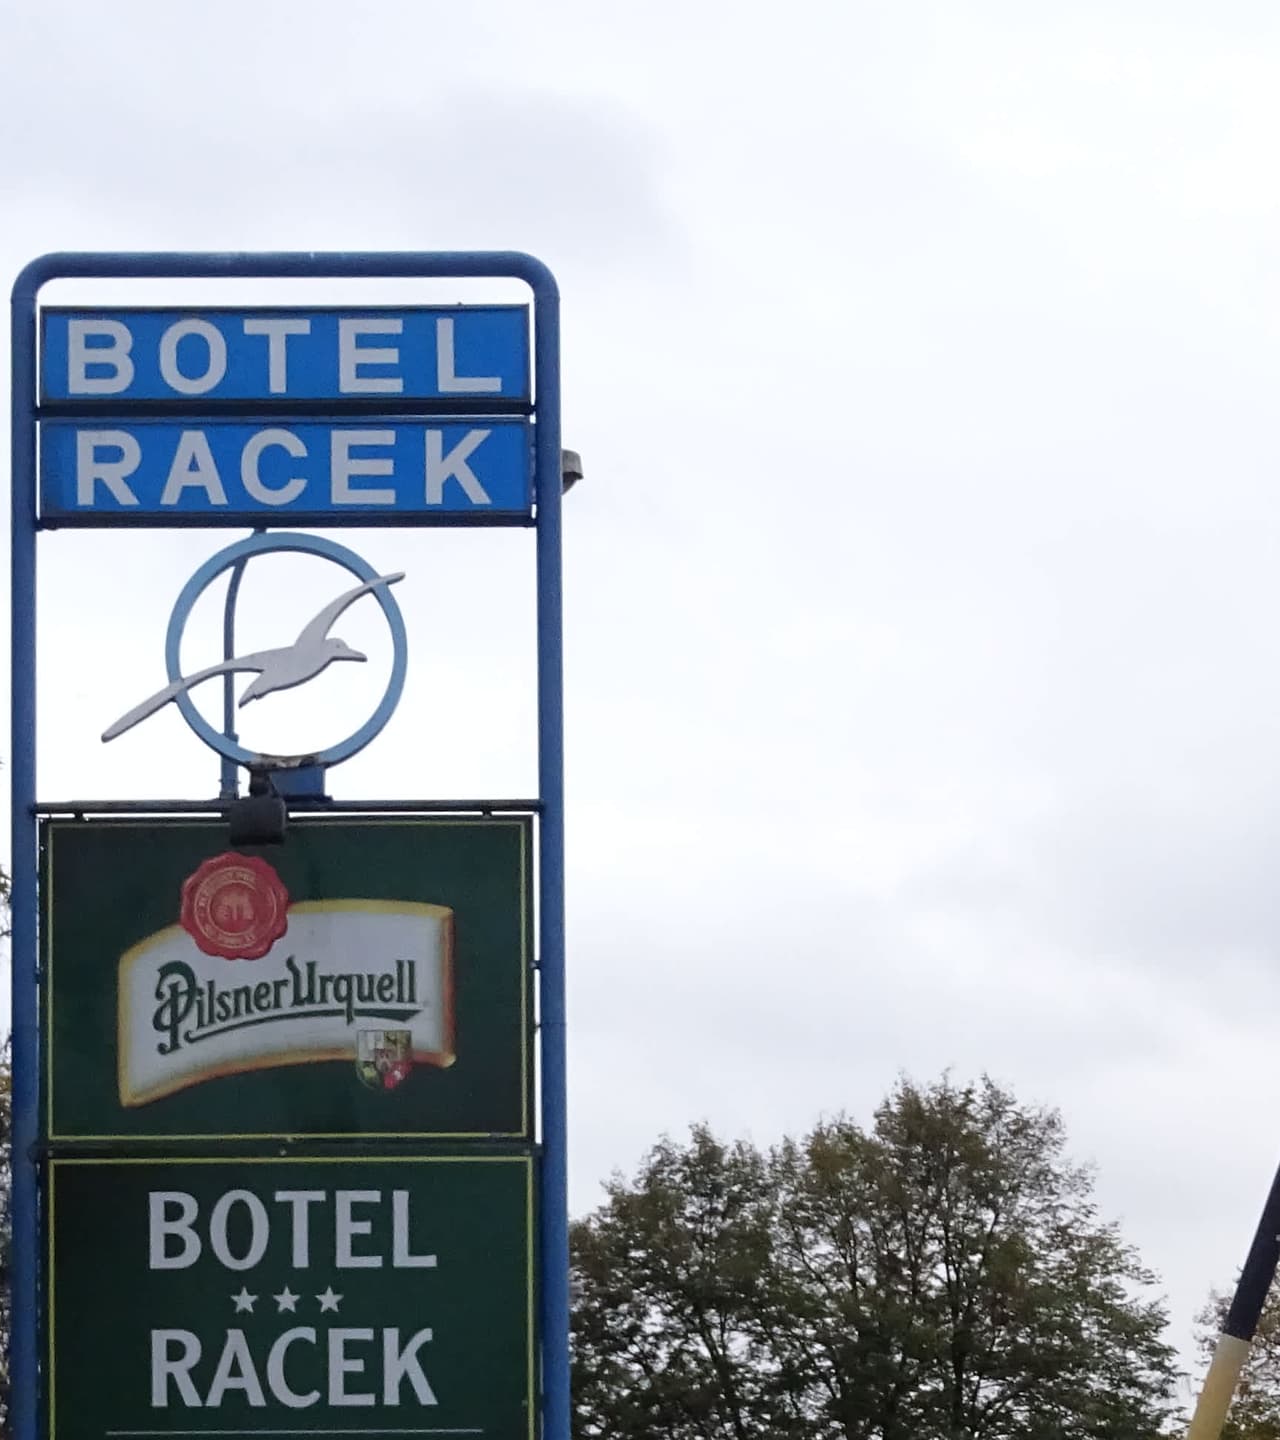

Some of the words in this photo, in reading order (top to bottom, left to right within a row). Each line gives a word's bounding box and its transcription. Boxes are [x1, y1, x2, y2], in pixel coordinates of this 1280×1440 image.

[67, 318, 502, 395] BOTEL
[76, 428, 493, 506] RACEK
[152, 960, 288, 1056] Pilsner
[286, 954, 417, 1026] Urquell
[148, 1189, 438, 1270] BOTEL
[150, 1326, 438, 1409] RACEK
